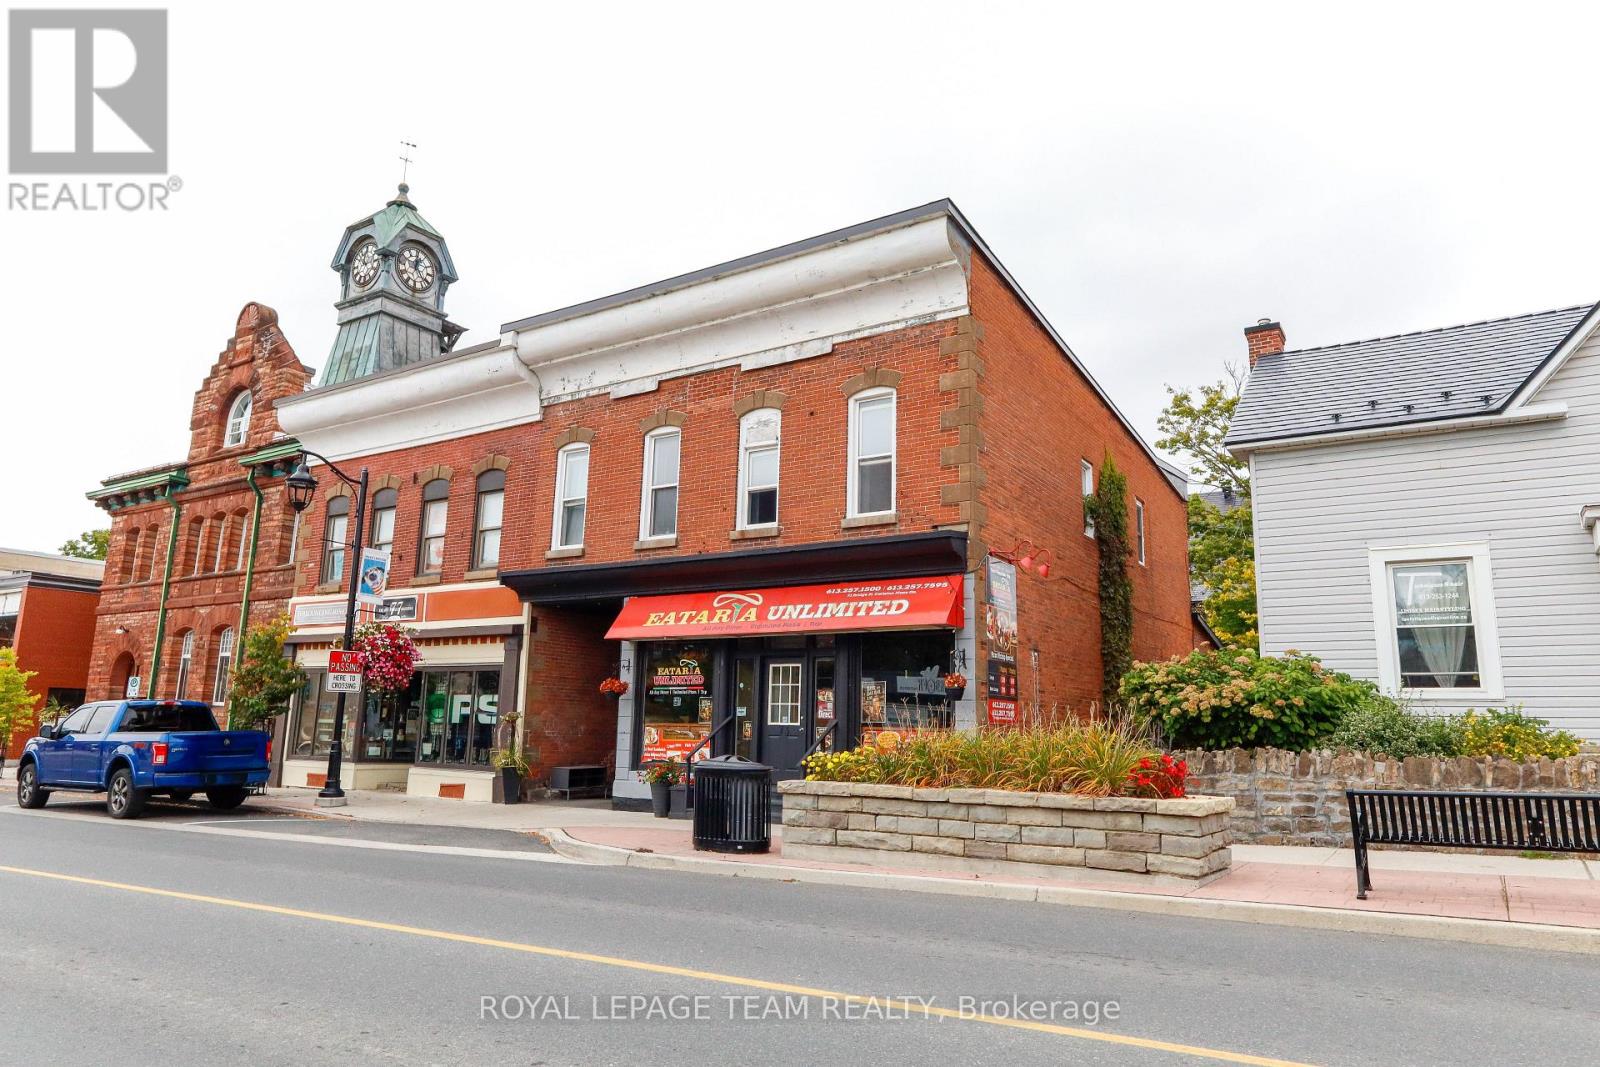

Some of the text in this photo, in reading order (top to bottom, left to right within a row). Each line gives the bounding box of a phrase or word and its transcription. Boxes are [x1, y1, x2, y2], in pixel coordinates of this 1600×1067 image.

[826, 585, 881, 595] 613.257.1500
[887, 582, 949, 591] 613.257.7595
[767, 599, 910, 620] UNLIMITED
[342, 653, 352, 662] NO
[331, 662, 360, 672] PASSING
[653, 675, 705, 686] UNLIMITED
[819, 709, 833, 719] Direct
